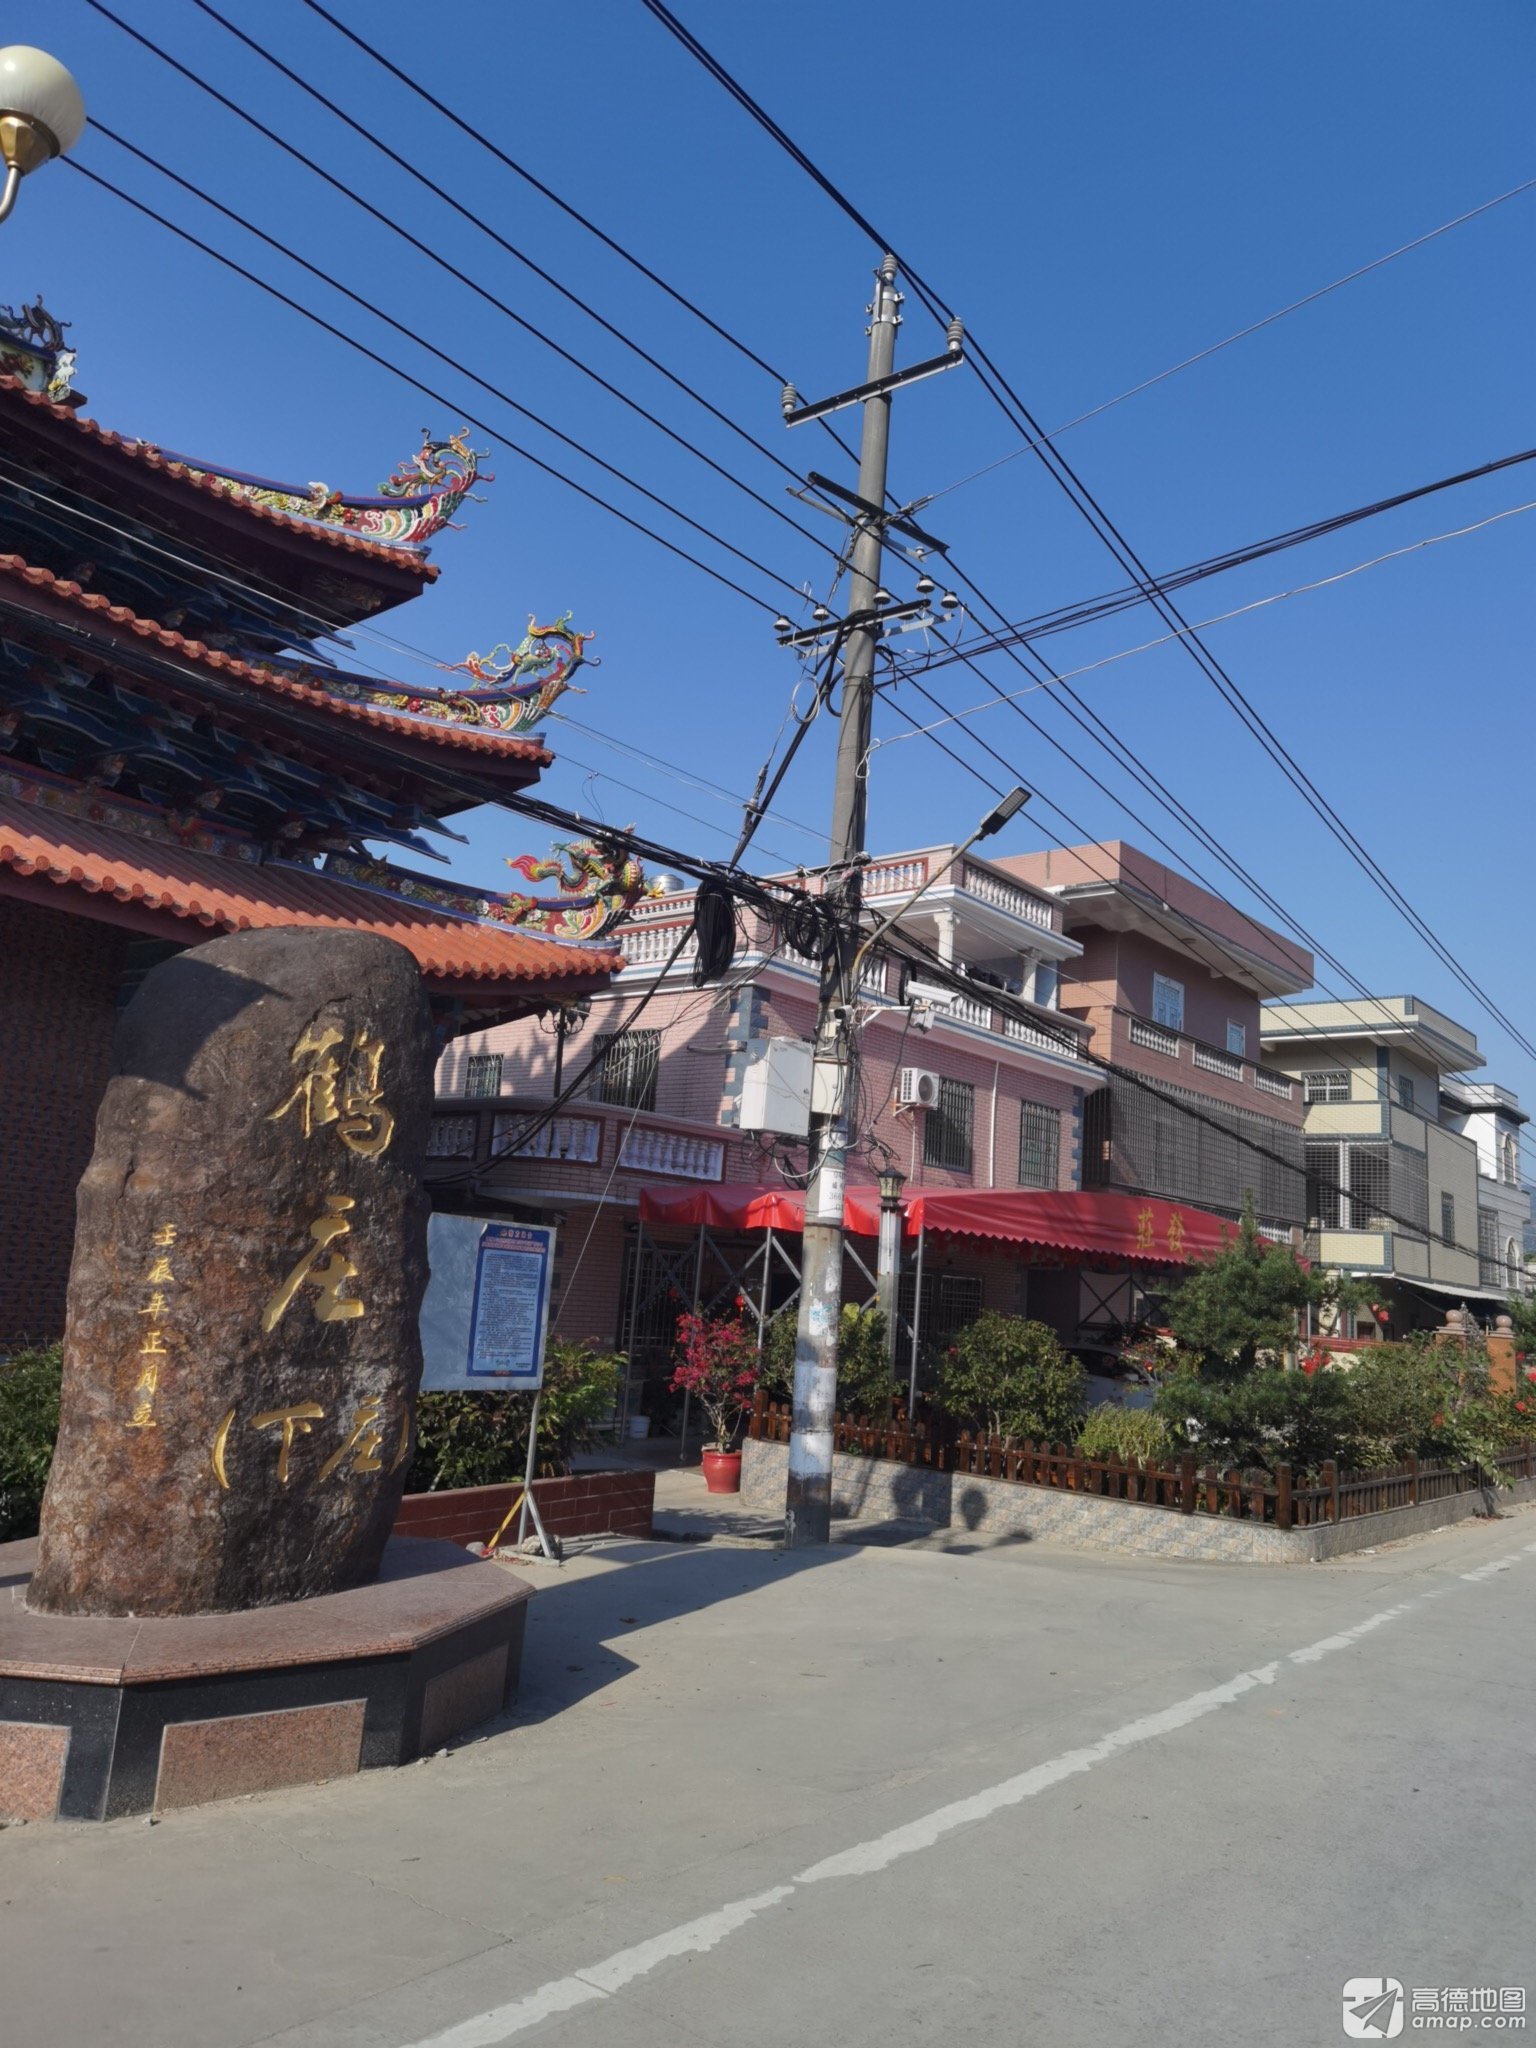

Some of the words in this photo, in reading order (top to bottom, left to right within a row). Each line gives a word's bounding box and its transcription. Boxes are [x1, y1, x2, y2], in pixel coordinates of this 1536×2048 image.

[125, 1223, 178, 1429] 壬辰年正月立
